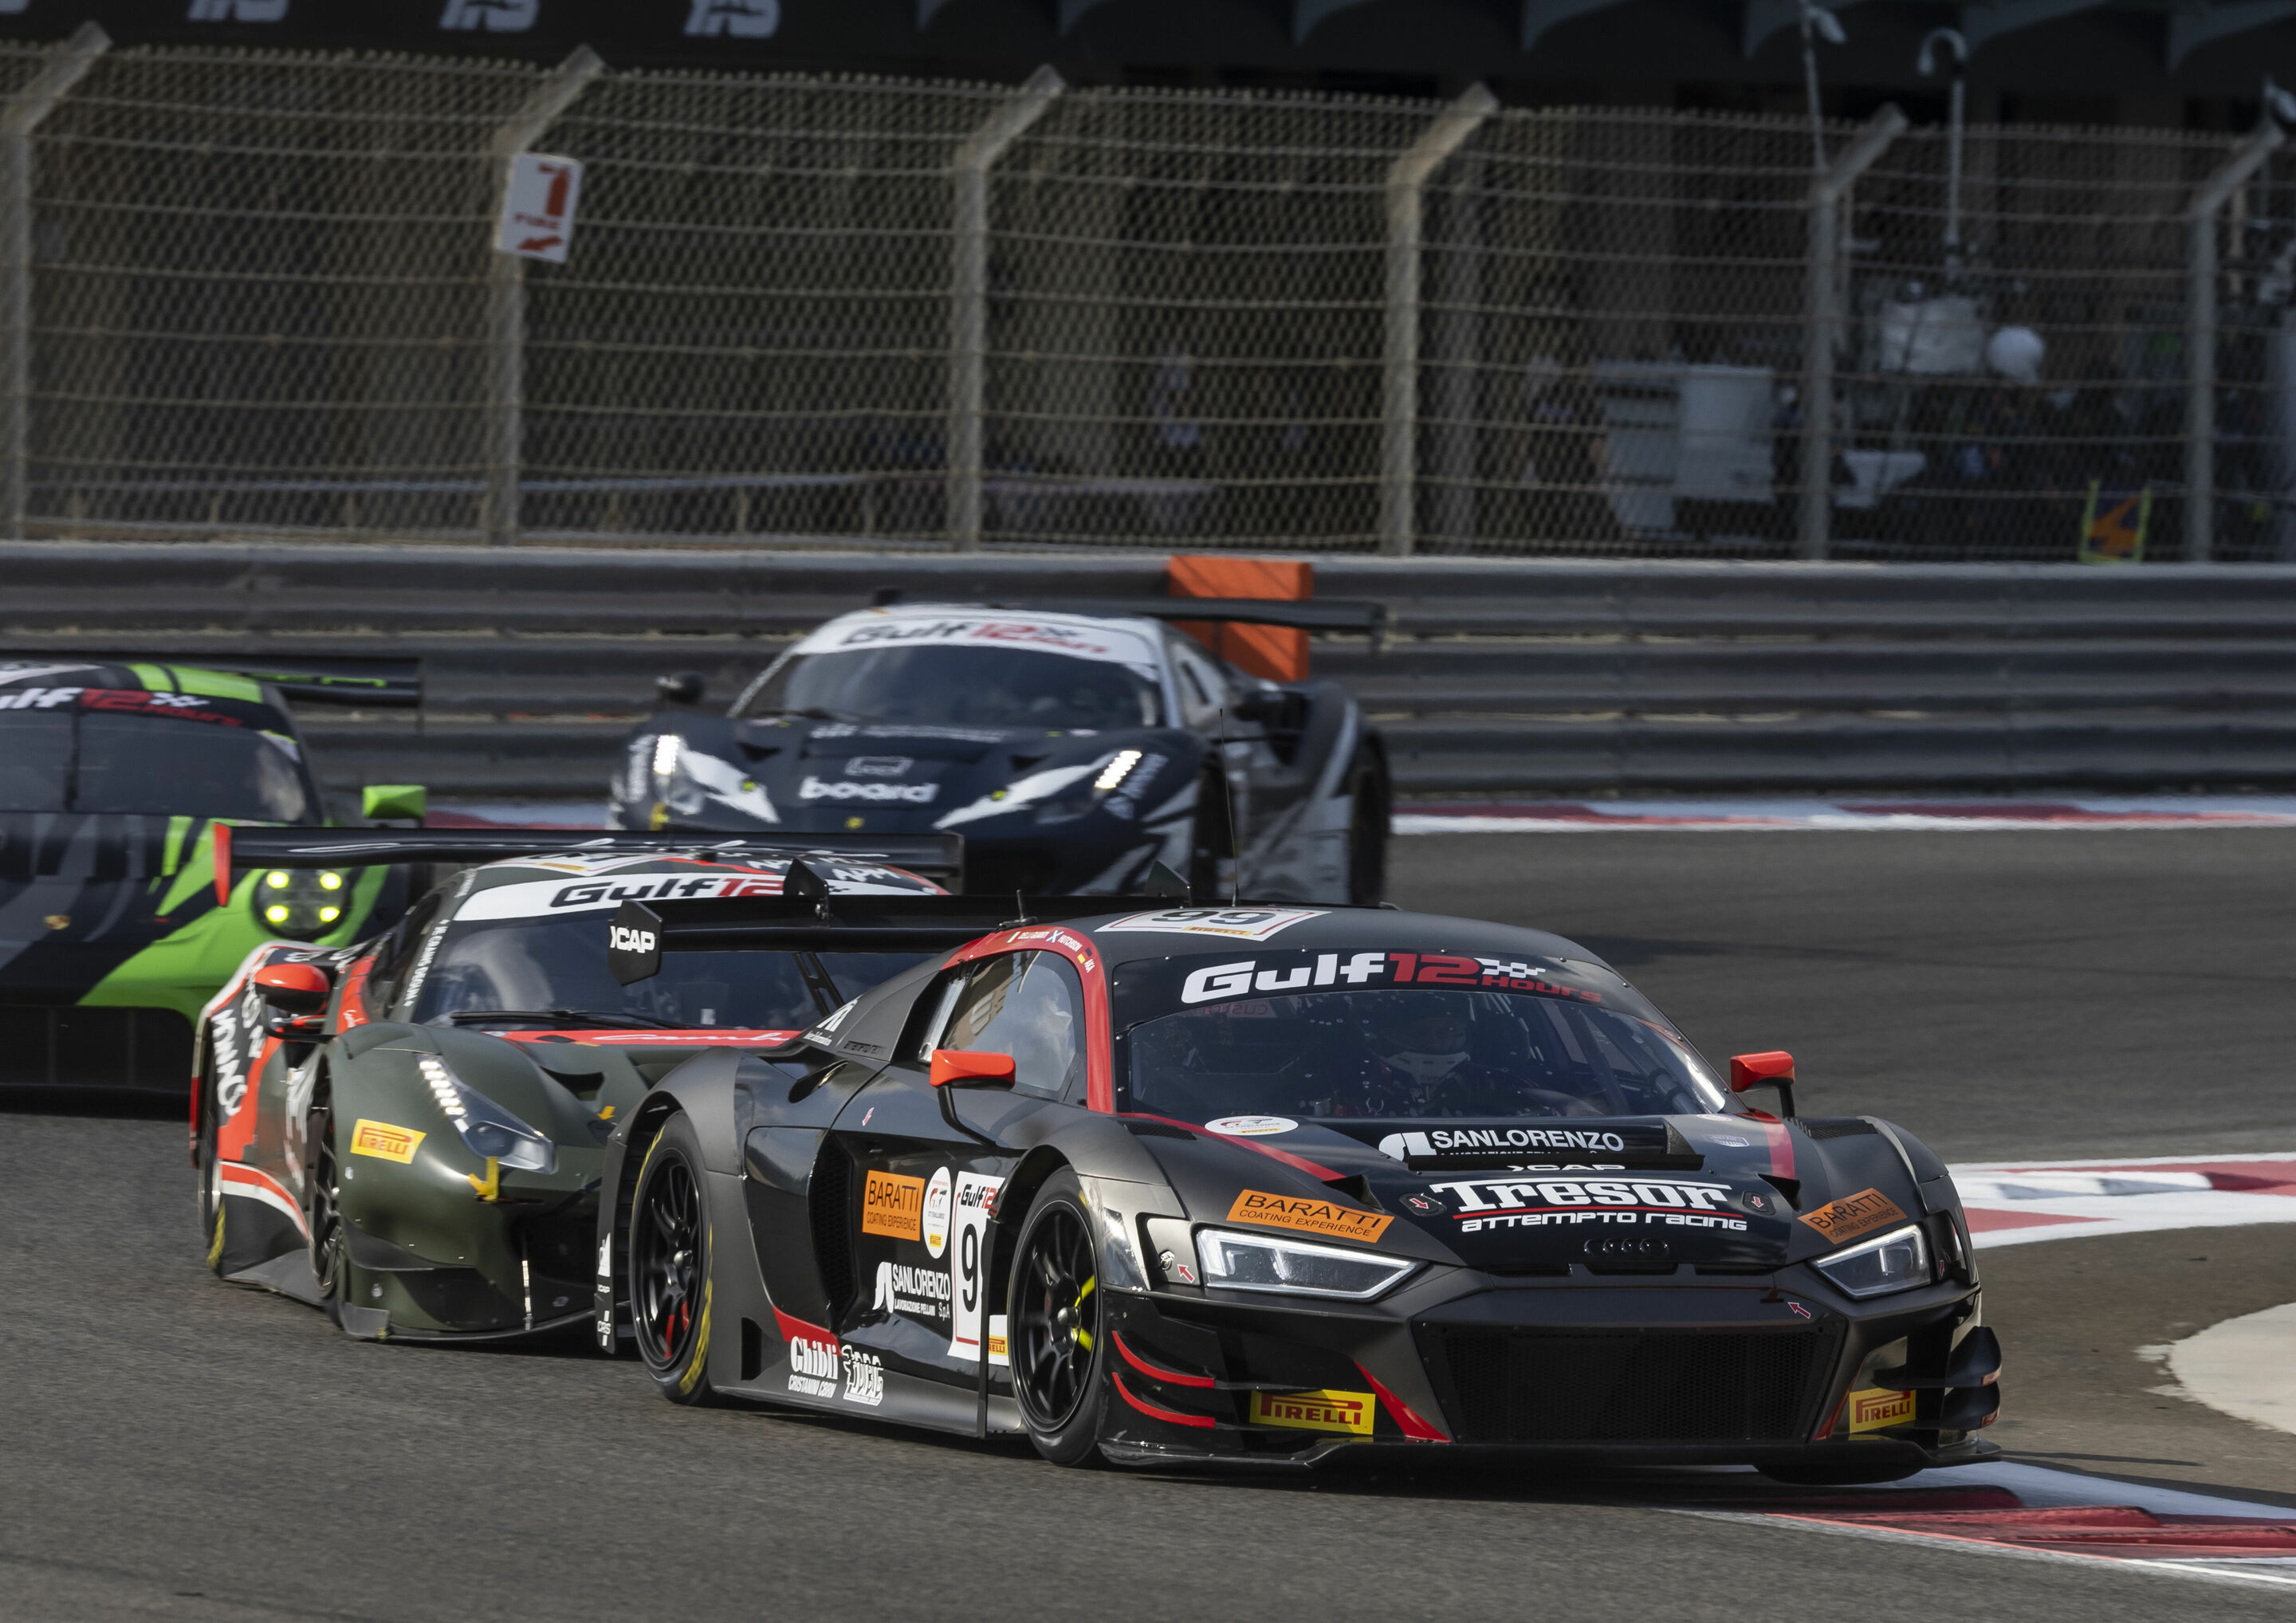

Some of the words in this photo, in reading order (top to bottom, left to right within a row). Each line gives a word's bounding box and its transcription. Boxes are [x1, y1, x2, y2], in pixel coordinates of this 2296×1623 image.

[799, 776, 940, 803] board
[1481, 975, 1602, 1003] Hours
[358, 1126, 411, 1155] PIRELLI
[1432, 1130, 1625, 1151] SANLORENZO
[868, 1180, 920, 1212] BARATTI
[1429, 1177, 1732, 1212] Tresor
[867, 1211, 887, 1227] COATING
[888, 1215, 917, 1232] EXPERIENCE
[1239, 1209, 1291, 1223] COATING
[1295, 1217, 1372, 1236] EXPERIENCE
[1244, 1194, 1382, 1228] BARATTI
[1808, 1193, 1889, 1229] BARATTI
[1858, 1207, 1900, 1228] EXPERIENCE
[893, 1263, 951, 1301] SANLORENZO
[790, 1336, 839, 1380] Ghibli
[989, 1338, 1006, 1354] RELLI
[1260, 1394, 1364, 1425] PIRELLI
[1856, 1391, 1911, 1424] PIRELLI
